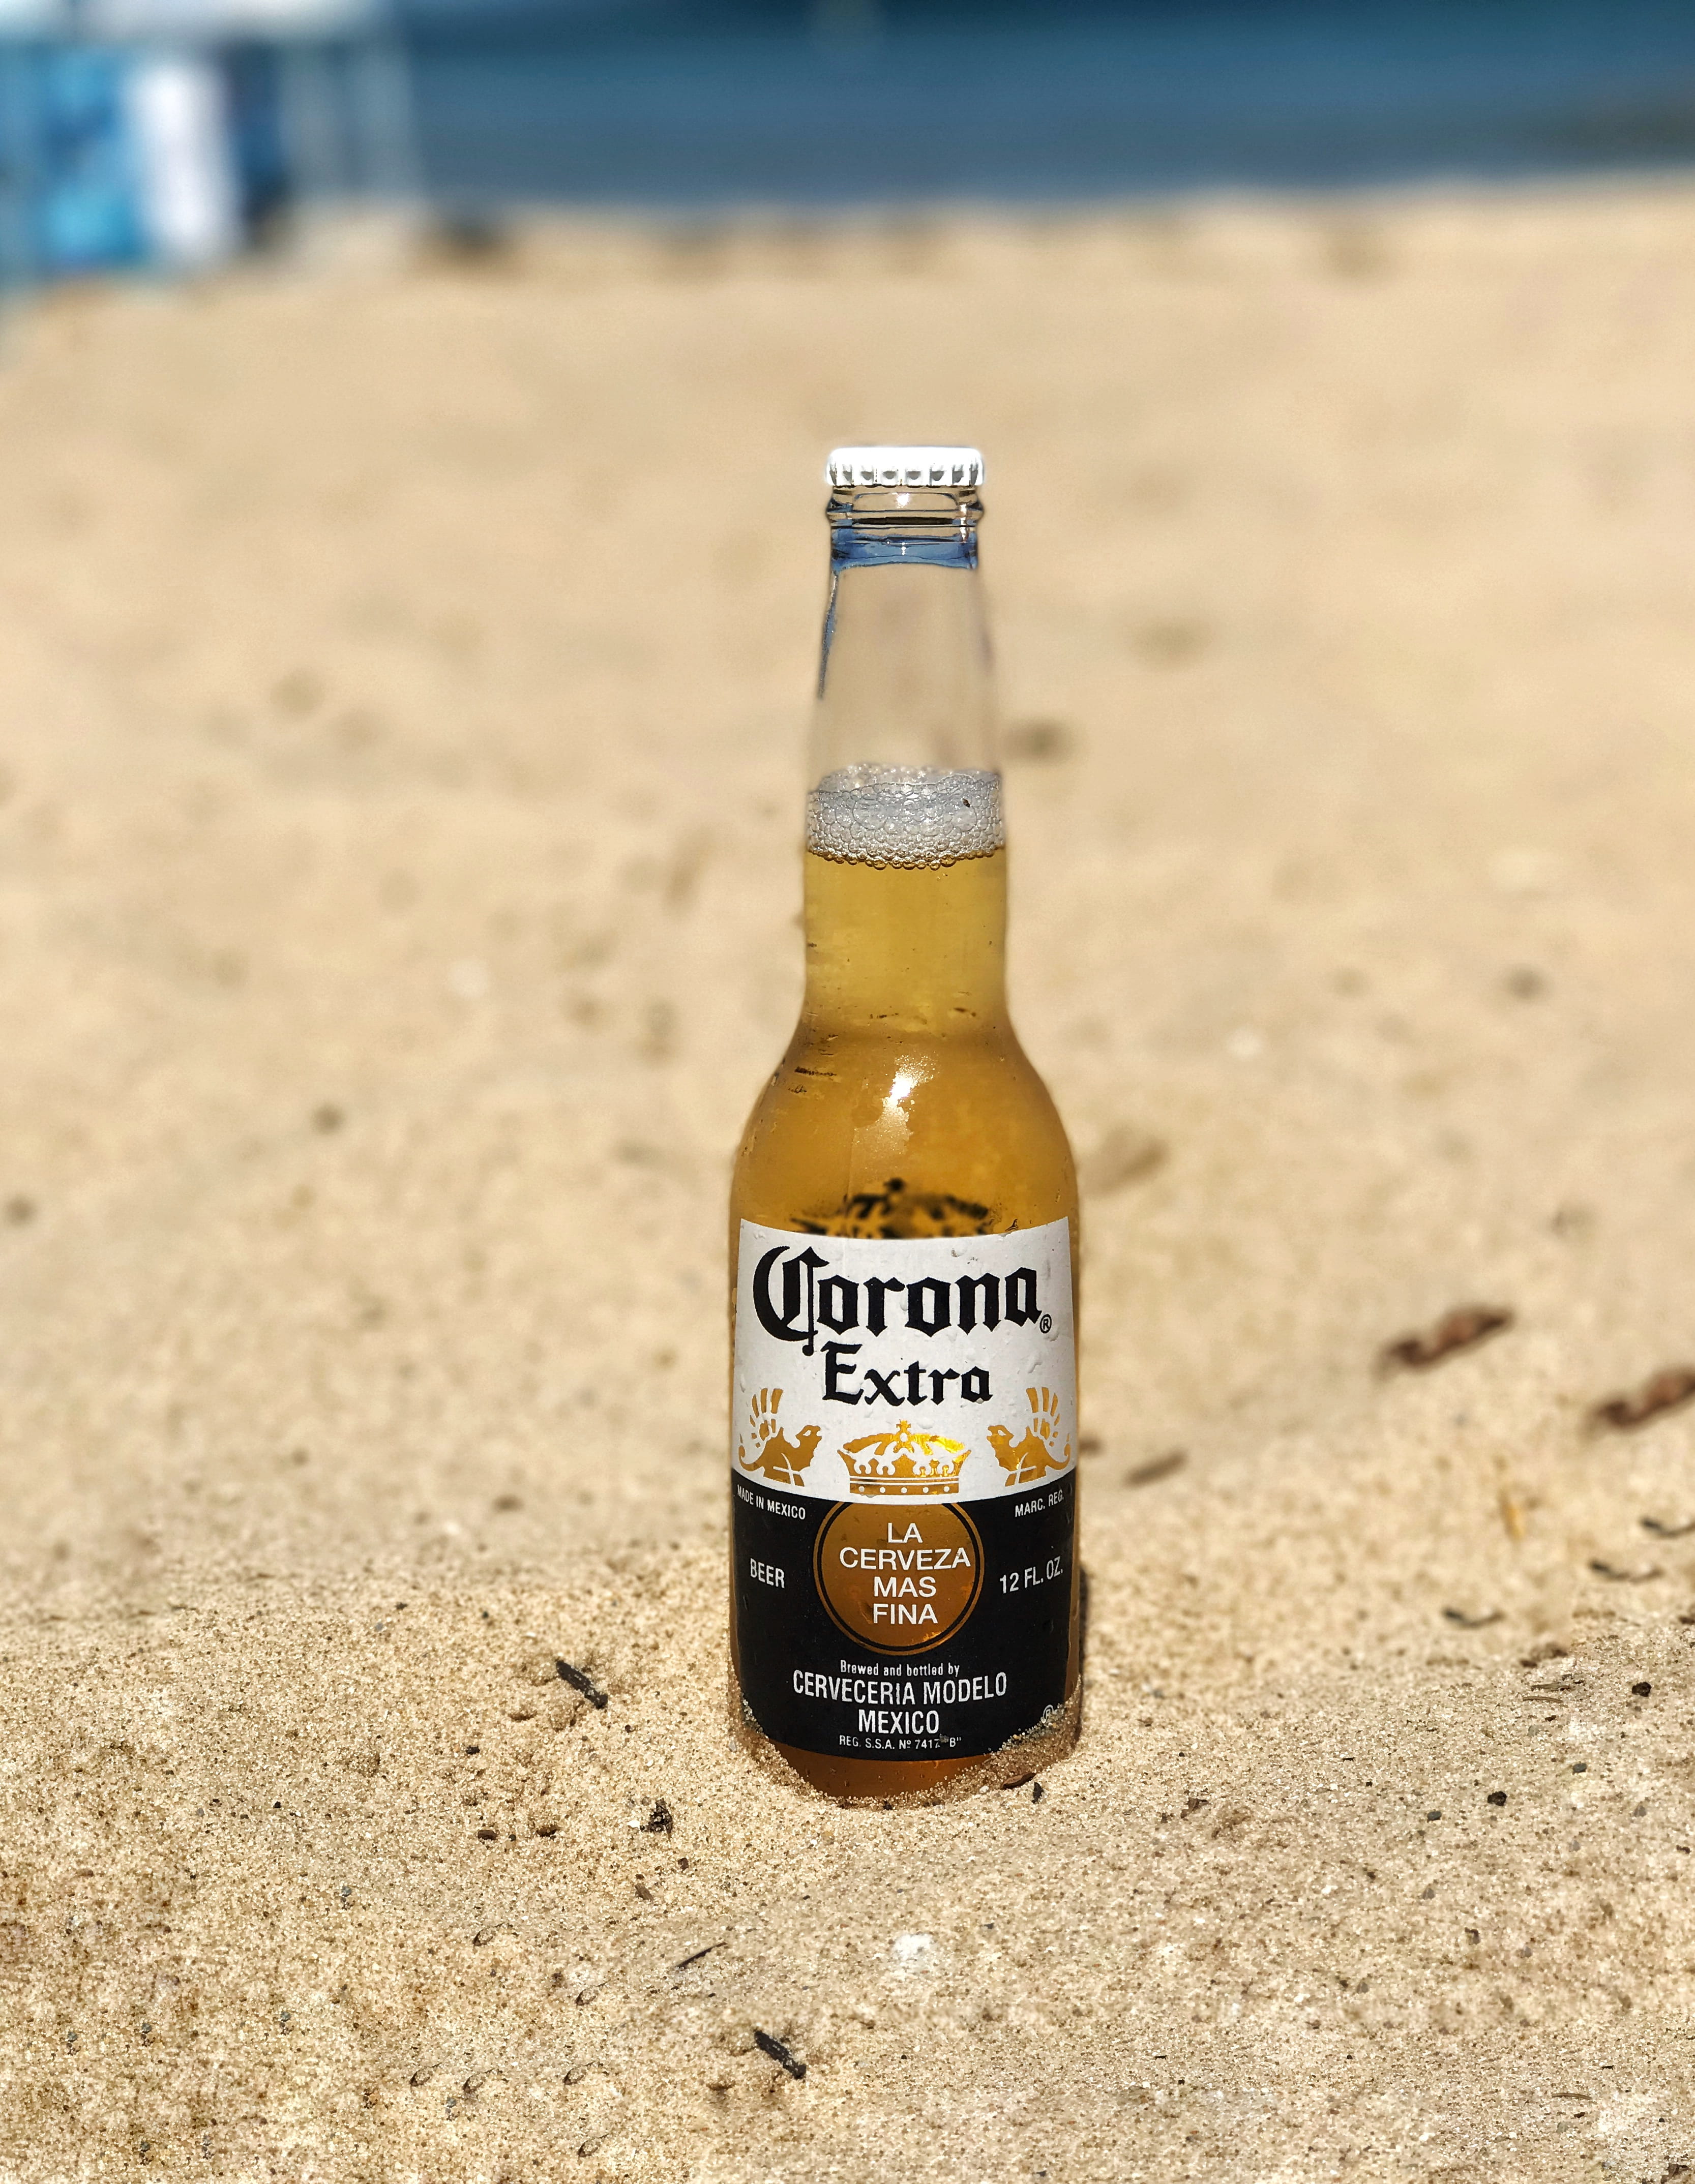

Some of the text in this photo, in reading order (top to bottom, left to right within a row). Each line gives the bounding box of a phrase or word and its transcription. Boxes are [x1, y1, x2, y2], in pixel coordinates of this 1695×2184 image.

[821, 1341, 993, 1407] Extra
[737, 1484, 806, 1520] MADE IN MEXICO
[1015, 1489, 1064, 1517] MARC. REG.
[888, 1522, 923, 1543] LA
[840, 1547, 971, 1570] CERVEZA
[750, 1558, 785, 1589] BEER
[999, 1555, 1063, 1594] 12 FL. OZ.
[874, 1576, 936, 1598] MAS
[873, 1603, 938, 1625] FINA
[840, 1659, 960, 1678] Brewed and bottled by
[793, 1669, 1007, 1705] CERVECERIA MODELO
[858, 1709, 939, 1734] MEXICO
[865, 1738, 895, 1750] S.S.A.
